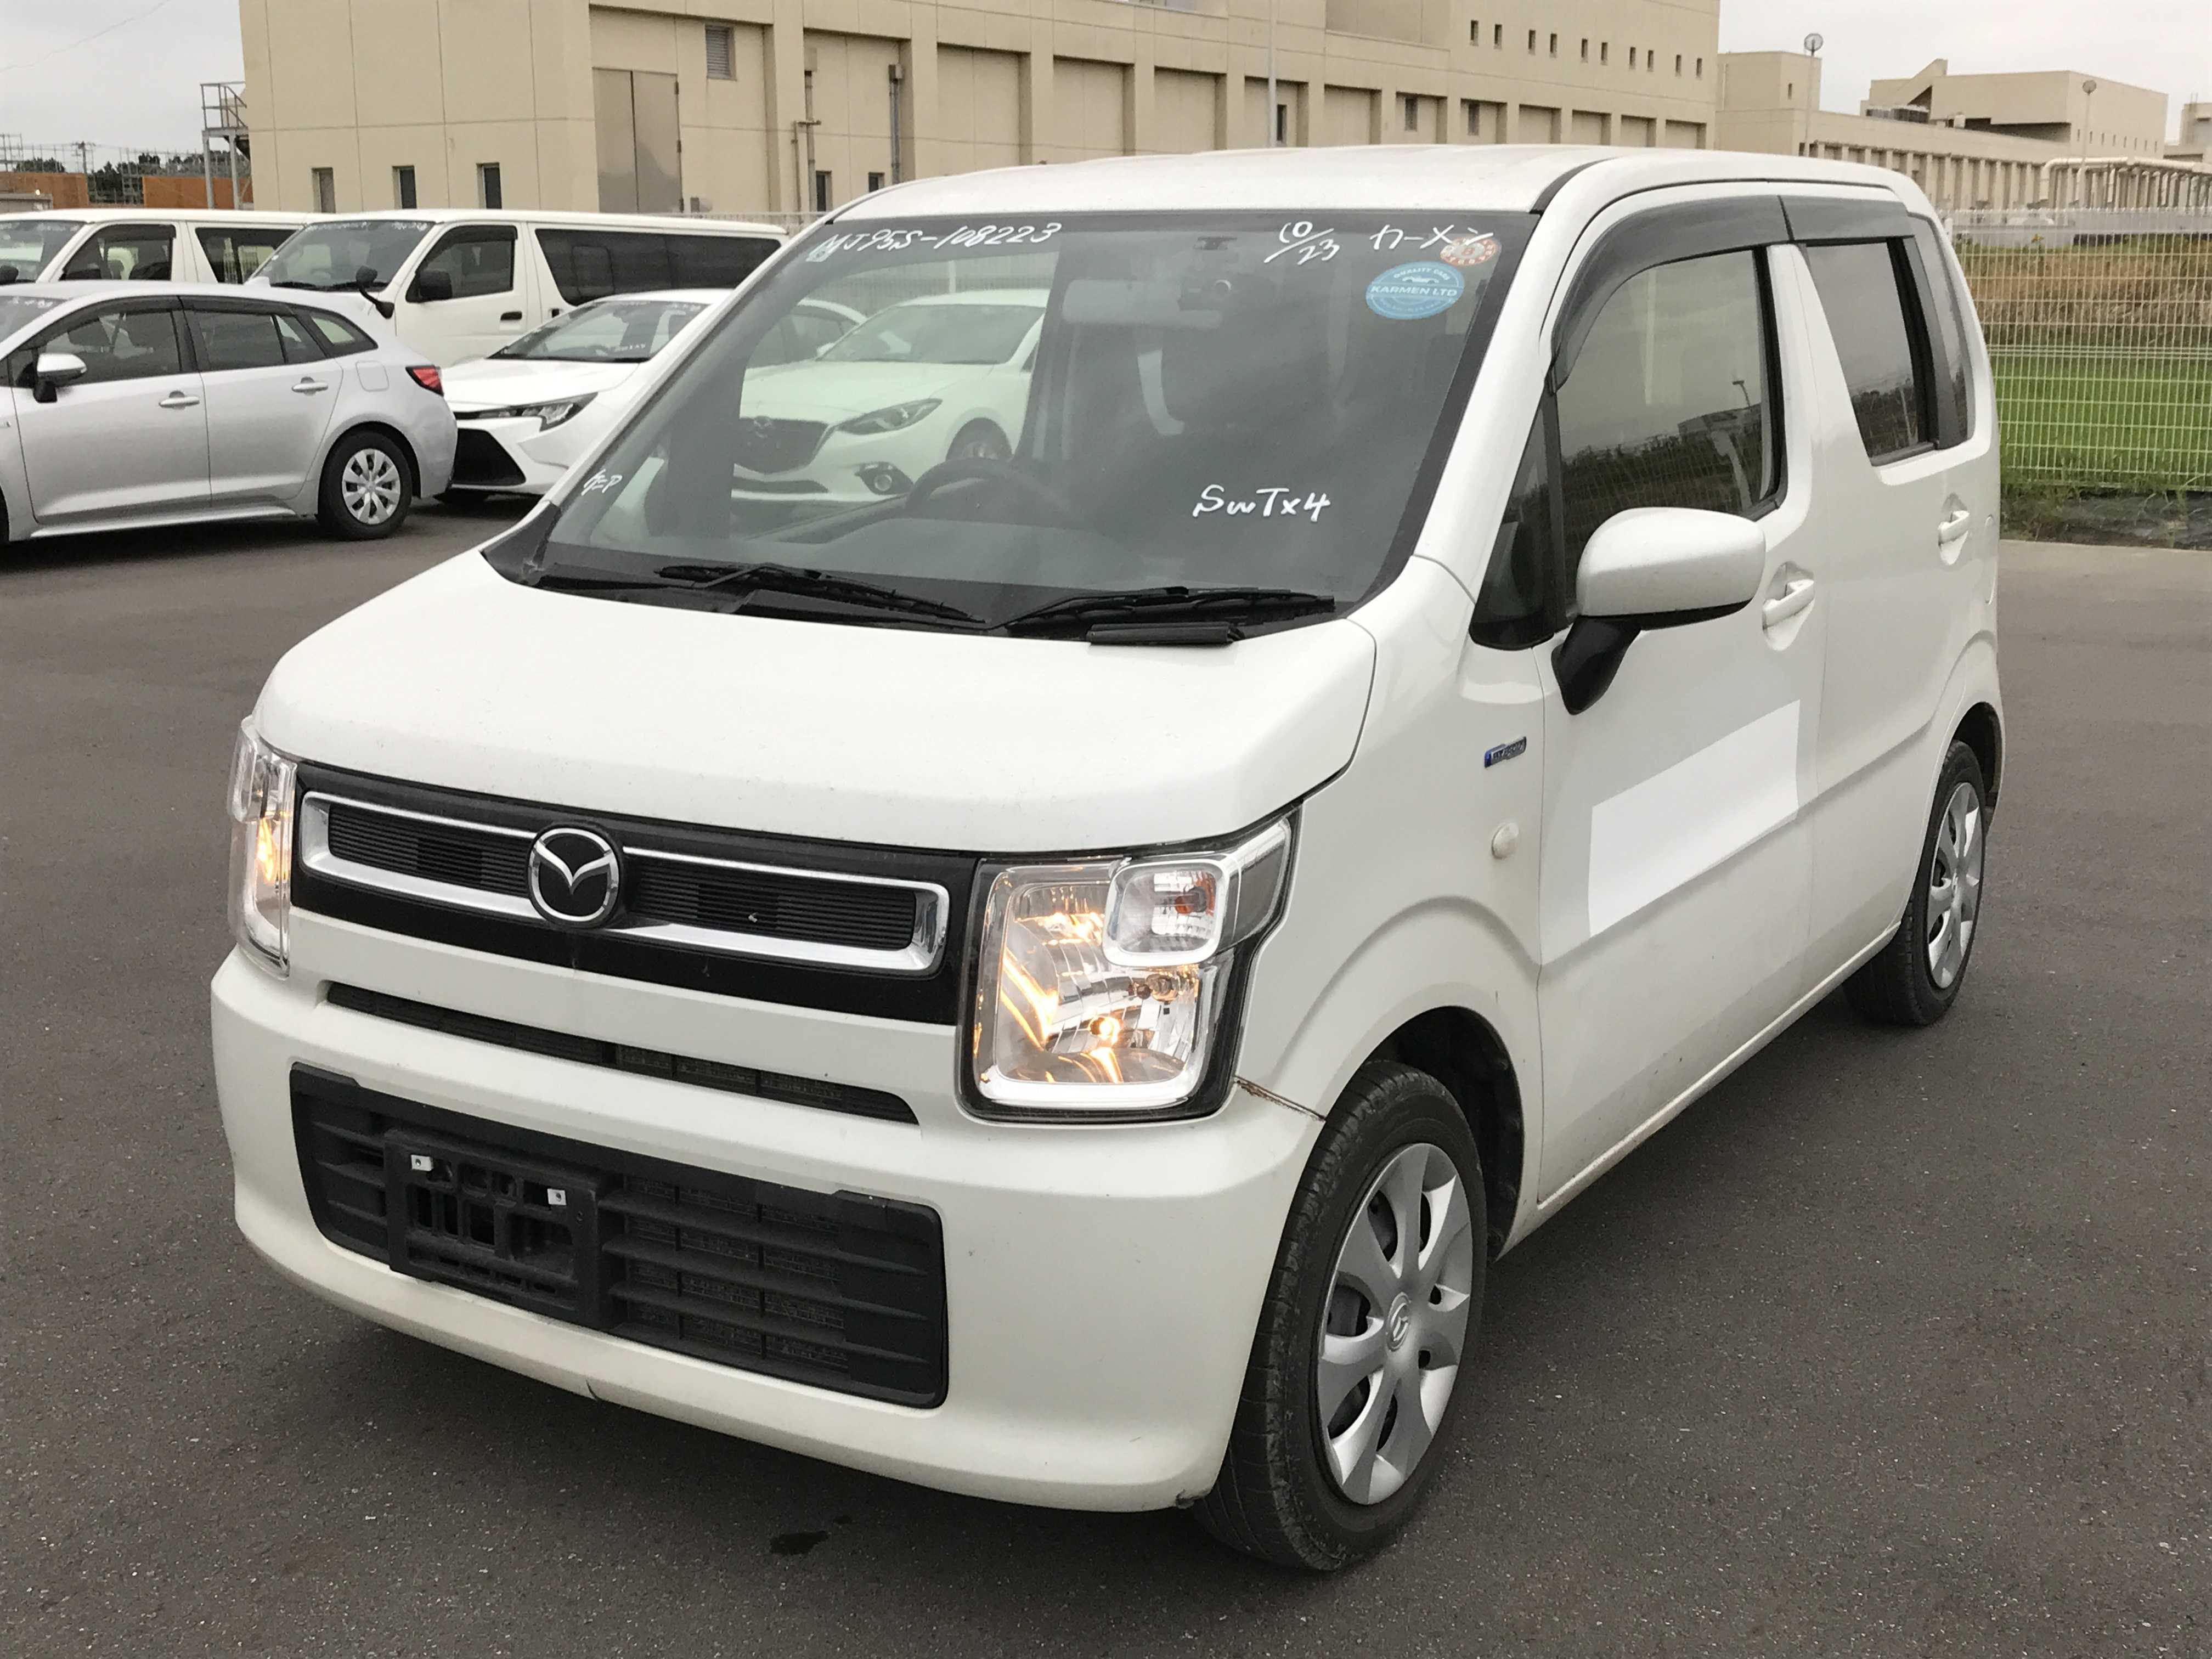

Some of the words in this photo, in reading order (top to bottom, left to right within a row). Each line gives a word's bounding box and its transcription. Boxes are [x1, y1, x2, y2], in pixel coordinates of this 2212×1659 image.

[1393, 267, 1432, 278] QUALITY
[1370, 286, 1429, 295] KARMEN
[1432, 289, 1458, 297] LTD
